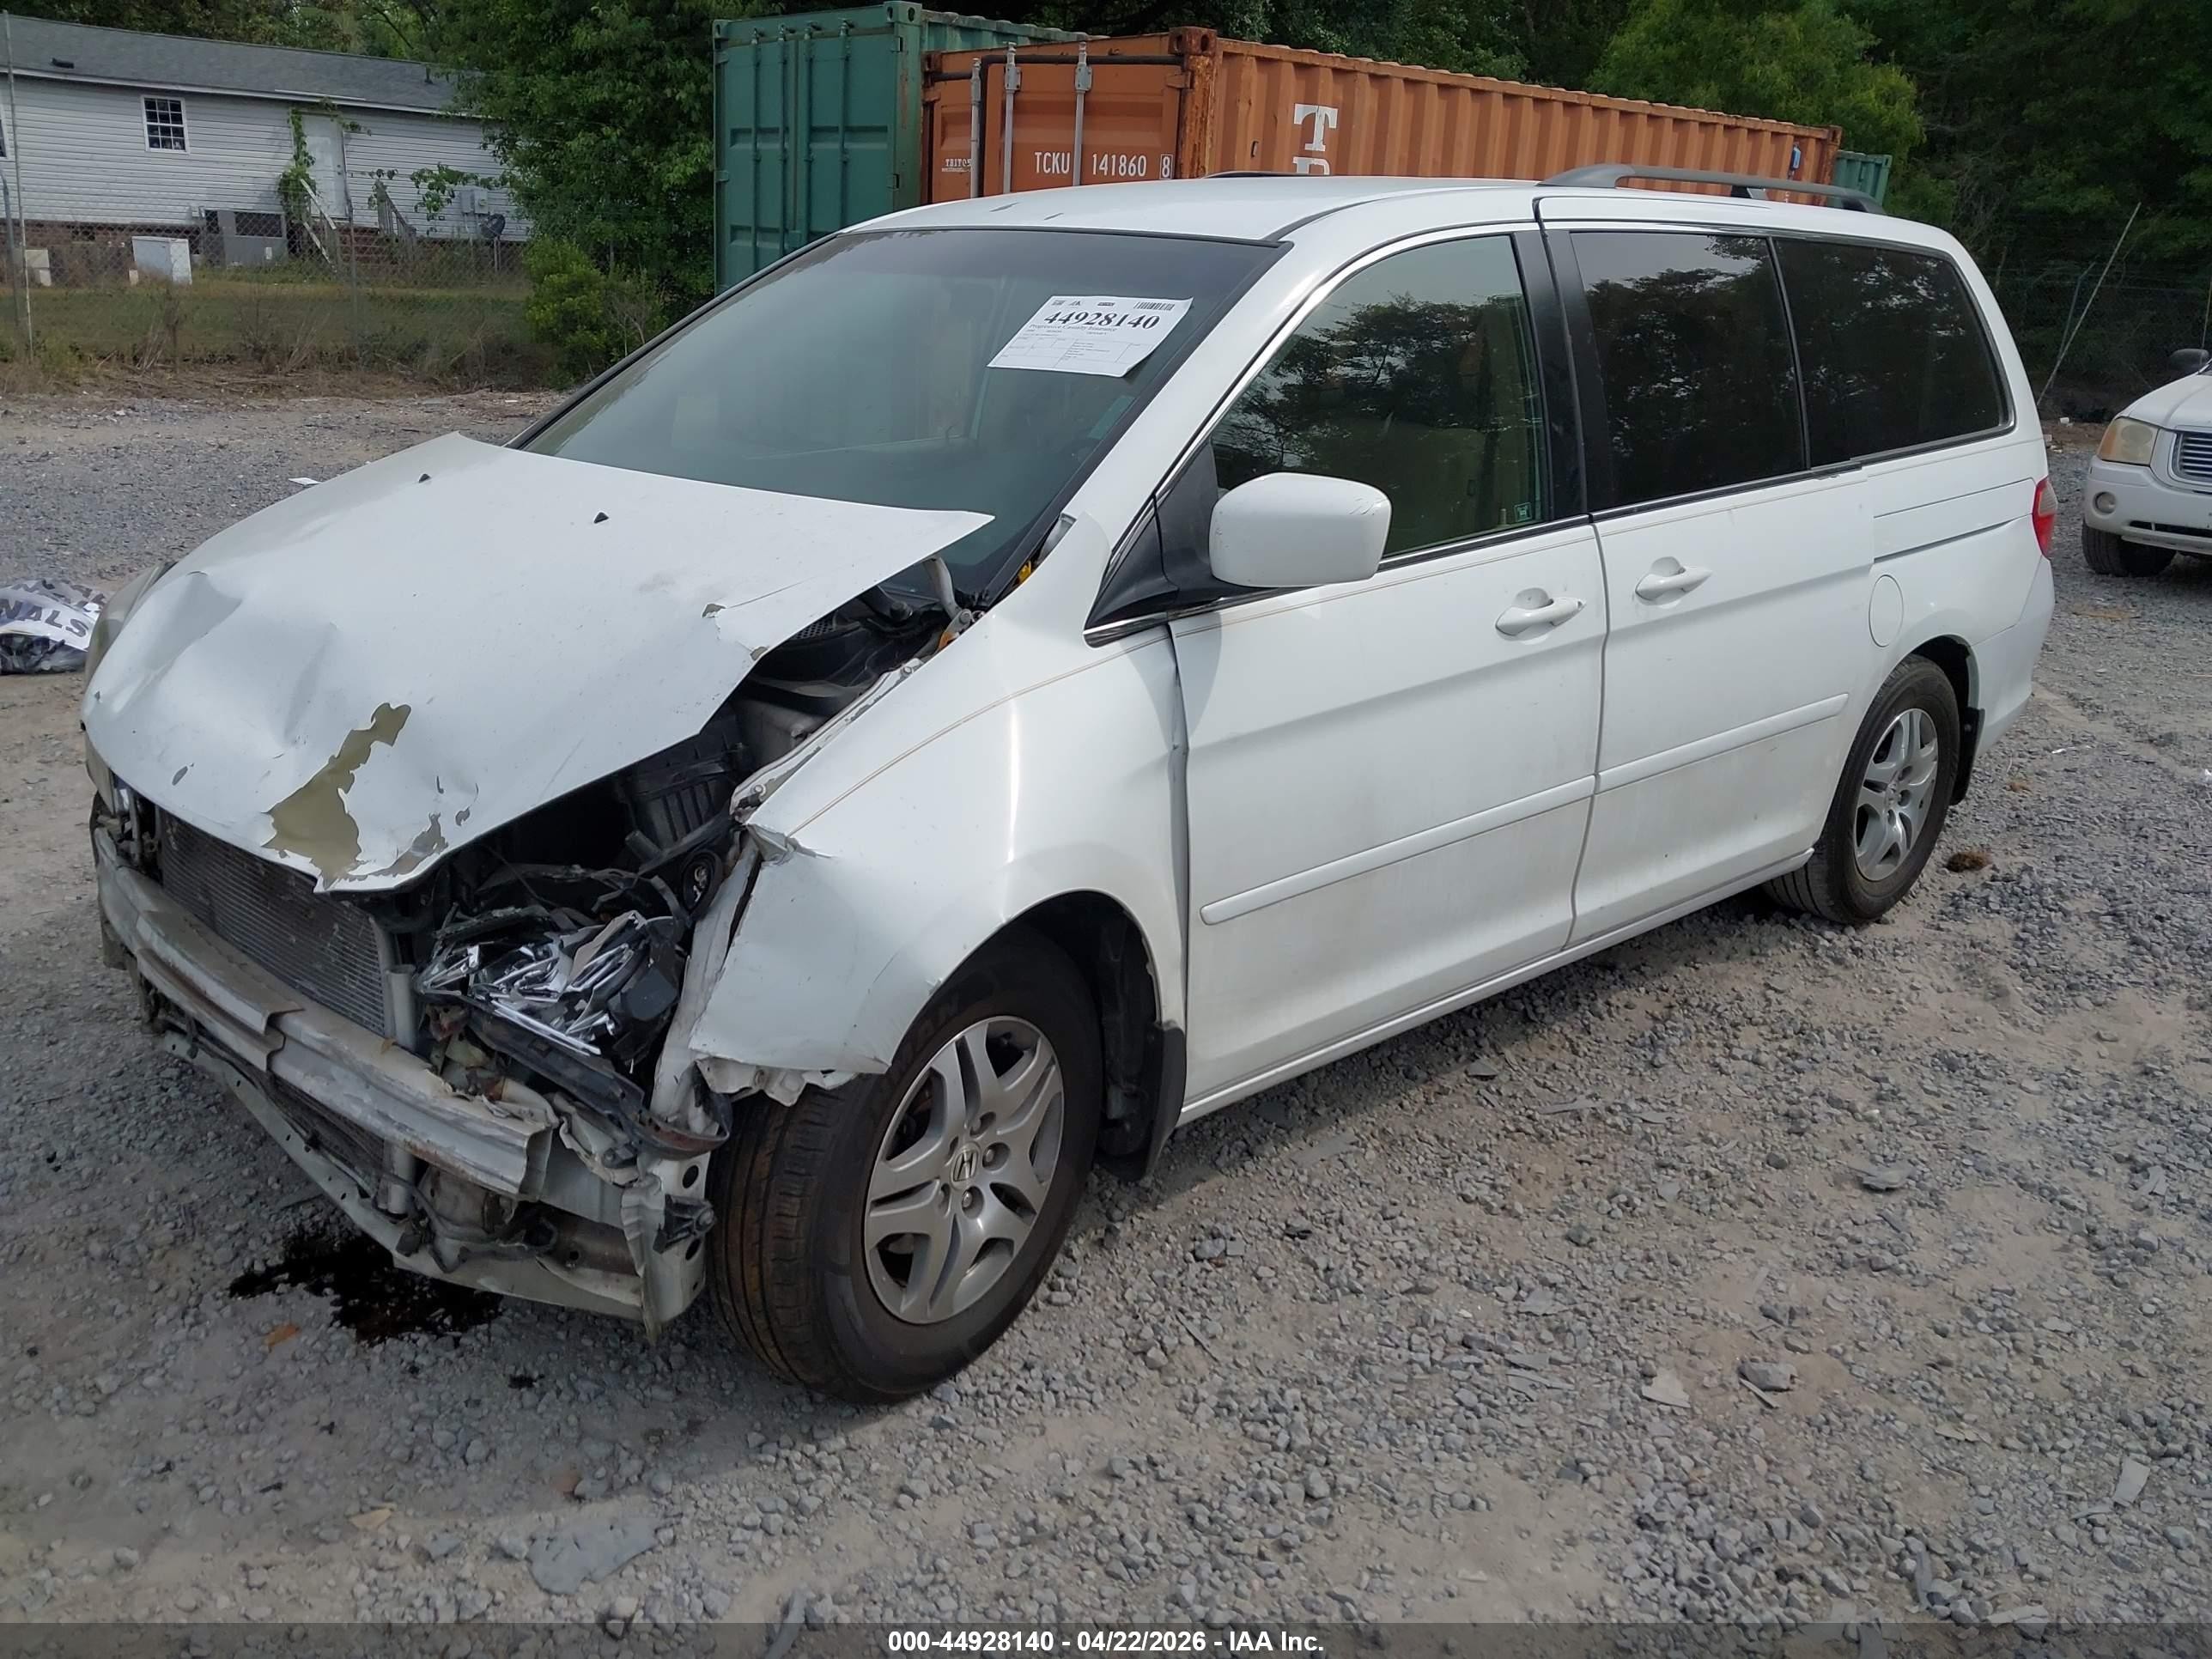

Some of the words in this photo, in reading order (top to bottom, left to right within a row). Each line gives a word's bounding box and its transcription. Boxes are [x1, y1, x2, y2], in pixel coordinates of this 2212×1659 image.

[1034, 151, 1071, 174] TCKU
[1092, 153, 1147, 177] 141860
[1161, 155, 1171, 179] 8
[1044, 311, 1160, 330] 44928140
